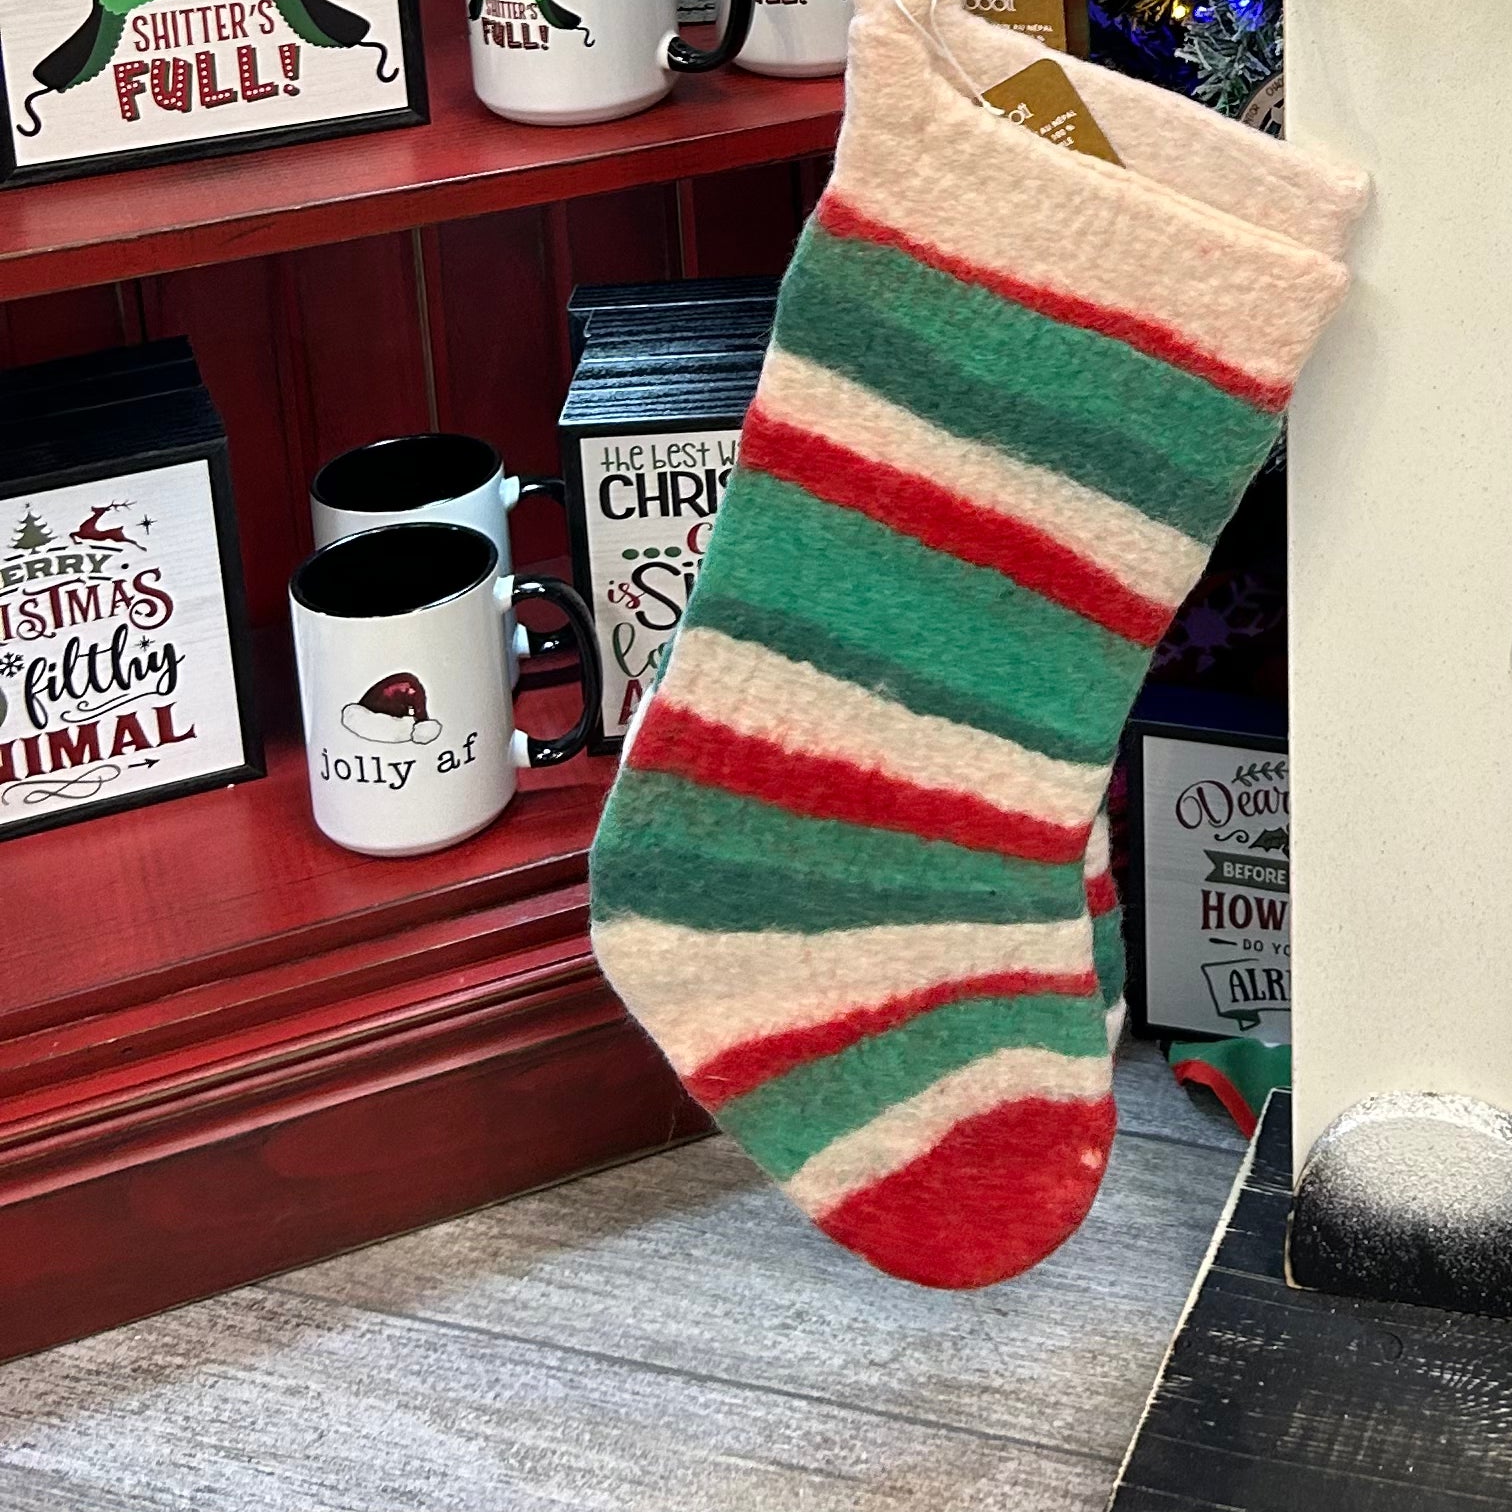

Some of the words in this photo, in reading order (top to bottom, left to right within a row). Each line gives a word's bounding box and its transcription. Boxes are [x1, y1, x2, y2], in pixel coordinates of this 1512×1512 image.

[481, 17, 550, 51] FULL!
[113, 43, 301, 122] FULL!
[600, 445, 644, 472] the
[651, 441, 711, 470] best
[599, 467, 732, 520] CHRI
[0, 554, 113, 588] ERRY
[0, 567, 175, 642] ISTMAS
[608, 580, 646, 610] is
[25, 623, 186, 731] filthy
[0, 702, 197, 785] IMAL
[320, 748, 417, 790] jolly
[437, 731, 478, 773] af
[1223, 861, 1287, 886] BEFORE
[1200, 888, 1289, 931] HOW
[1243, 938, 1264, 952] DO
[1271, 942, 1291, 957] YO
[1229, 968, 1291, 1003] ALR
